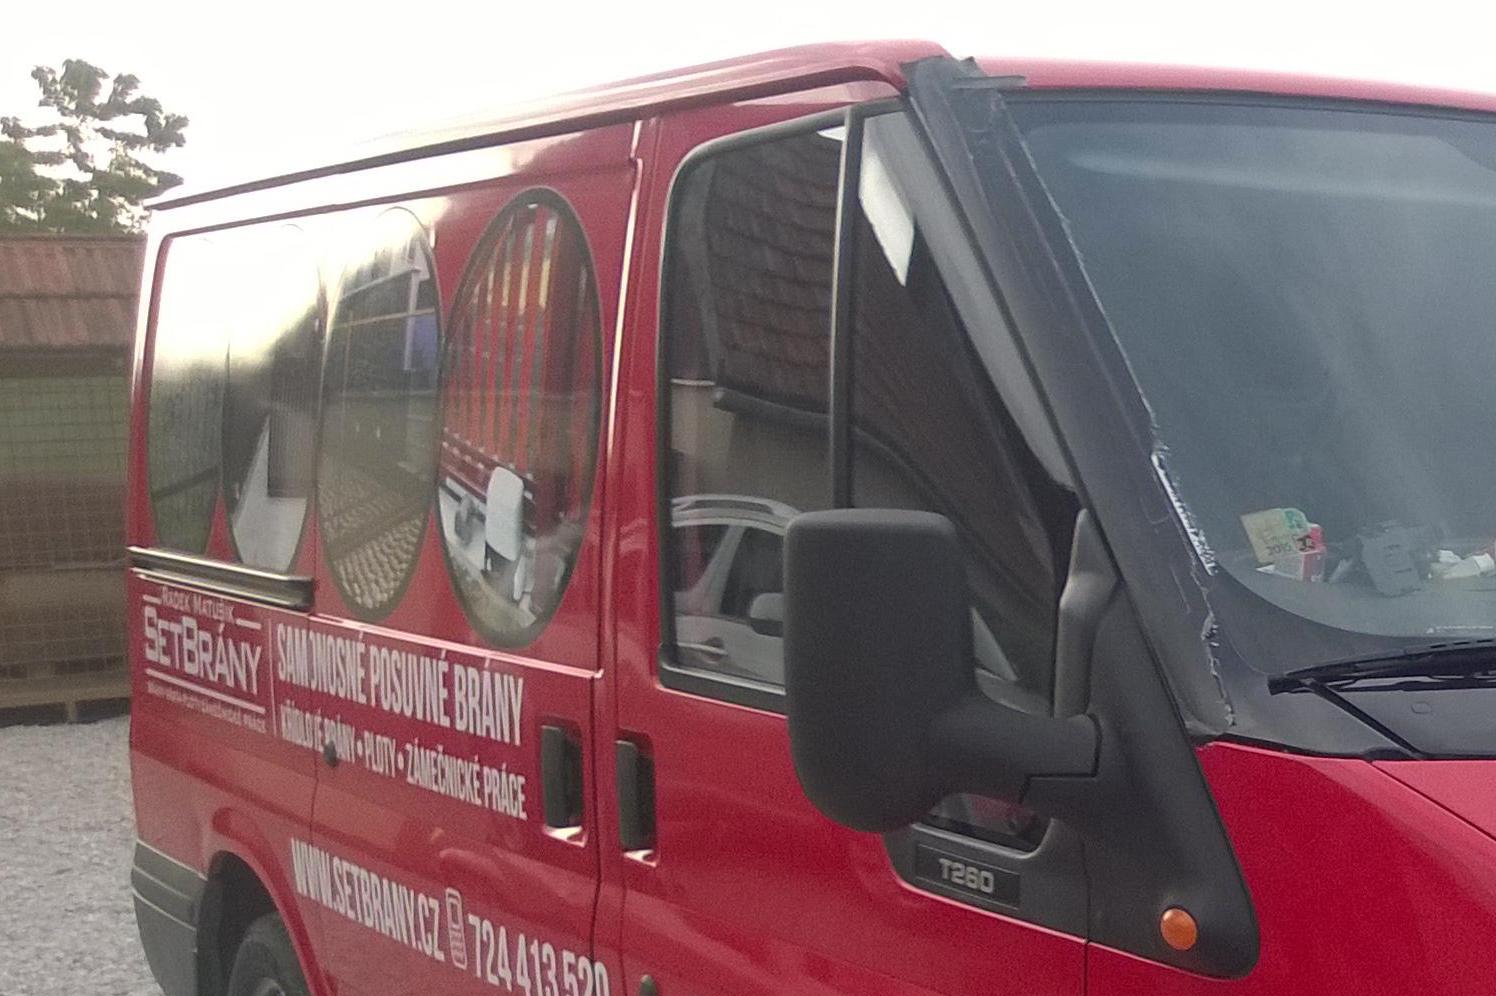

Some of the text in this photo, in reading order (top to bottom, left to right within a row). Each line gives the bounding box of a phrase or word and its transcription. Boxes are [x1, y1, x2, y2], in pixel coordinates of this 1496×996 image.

[144, 605, 262, 696] SETBRÁNY
[369, 643, 451, 728] POSUVNÉ
[453, 656, 524, 747] BRÁNY
[363, 729, 397, 779] PLOTY
[404, 736, 482, 806] ZÁMEČNICKÉ
[482, 762, 529, 822] PRÁCE
[291, 836, 446, 963] WWW.SETBRANY.CZ
[467, 912, 513, 993] 724
[938, 857, 995, 894] T260
